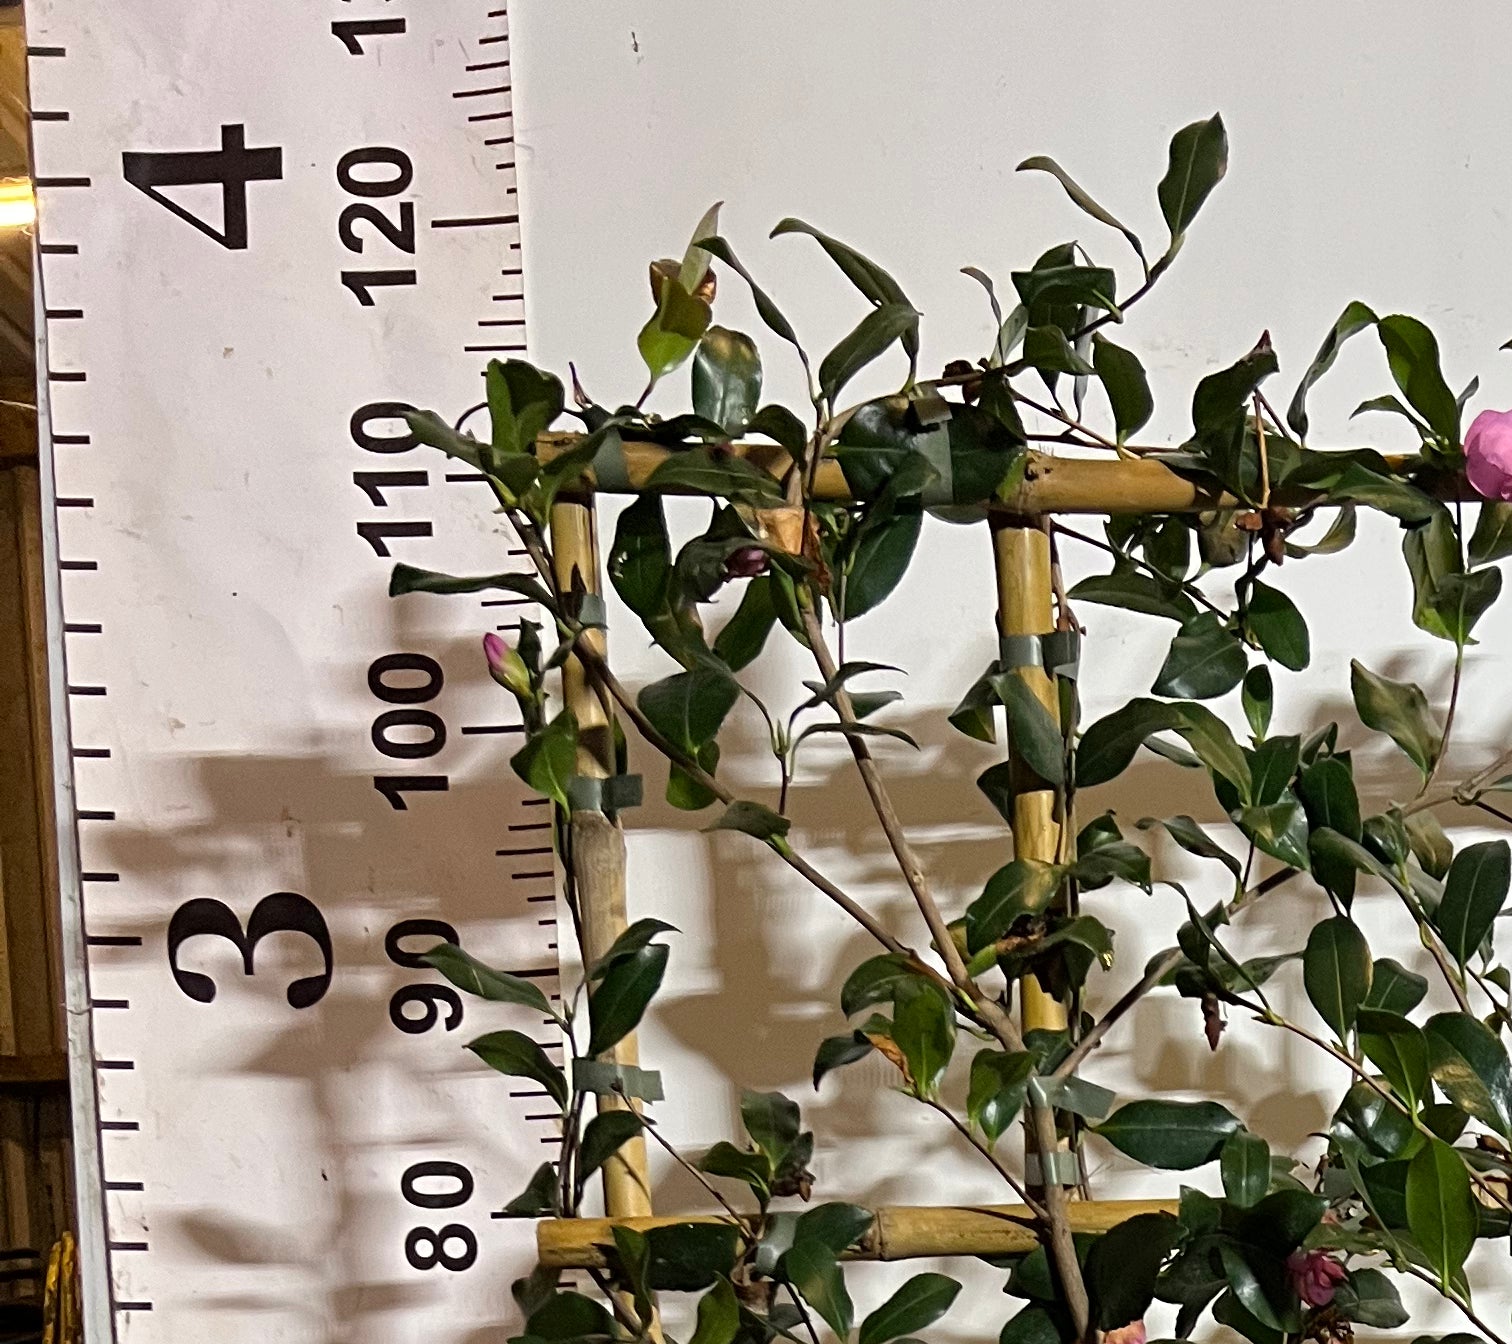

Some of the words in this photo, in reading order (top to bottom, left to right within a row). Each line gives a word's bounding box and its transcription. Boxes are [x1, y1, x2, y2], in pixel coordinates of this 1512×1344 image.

[122, 124, 282, 249] 4
[337, 147, 416, 306] 120
[351, 403, 434, 556] 110
[368, 653, 449, 810] 100
[168, 892, 333, 1009] 3
[385, 919, 463, 1034] 90
[401, 1162, 477, 1271] 80
